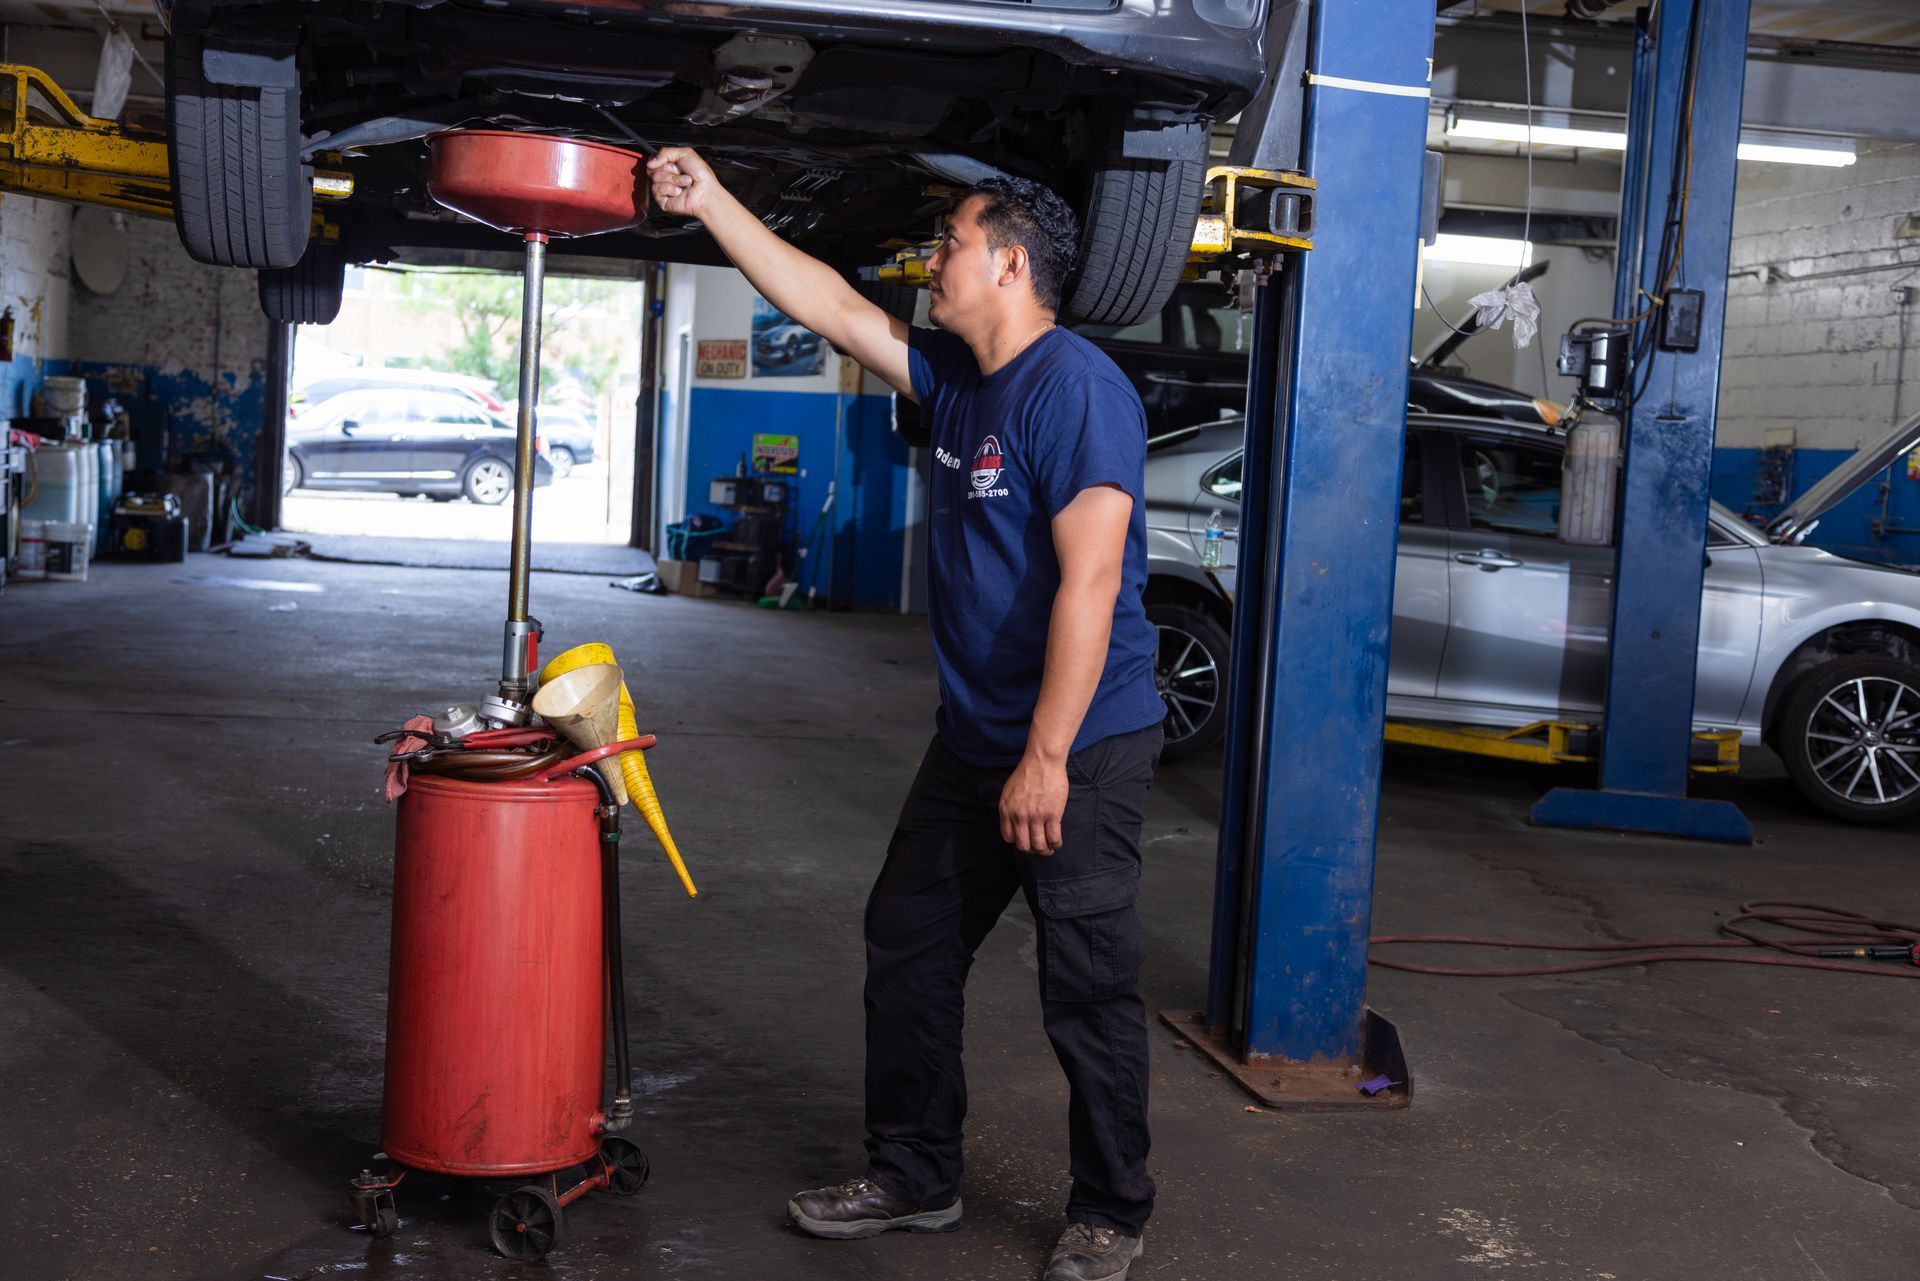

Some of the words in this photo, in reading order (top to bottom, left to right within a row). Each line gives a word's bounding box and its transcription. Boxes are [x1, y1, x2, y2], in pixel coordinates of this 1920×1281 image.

[698, 343, 746, 361] MECHANIC
[701, 362, 714, 375] ON
[717, 362, 740, 375] DUTY
[755, 445, 797, 457] INTERSTATE
